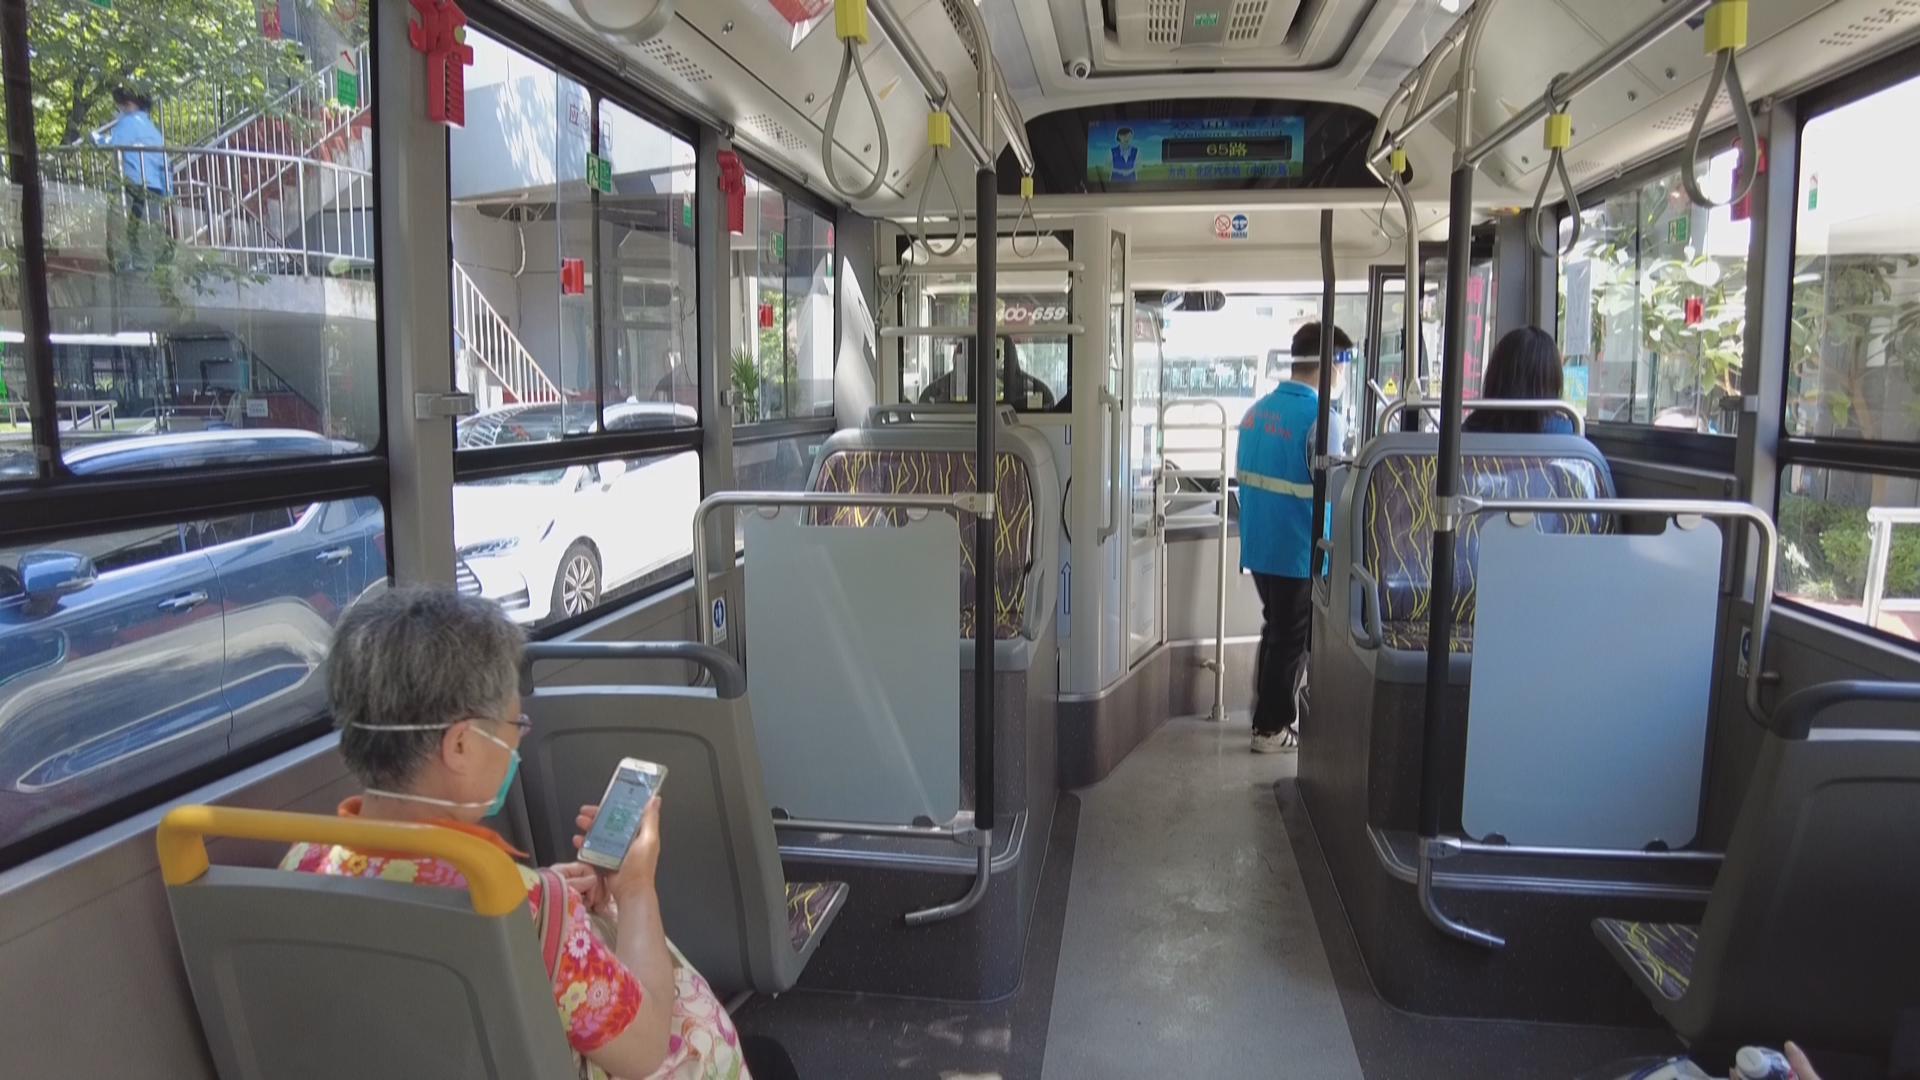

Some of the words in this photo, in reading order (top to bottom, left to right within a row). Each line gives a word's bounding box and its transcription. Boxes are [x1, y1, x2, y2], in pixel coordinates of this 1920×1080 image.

[569, 103, 611, 142] 应急口
[1206, 142, 1248, 157] 65路
